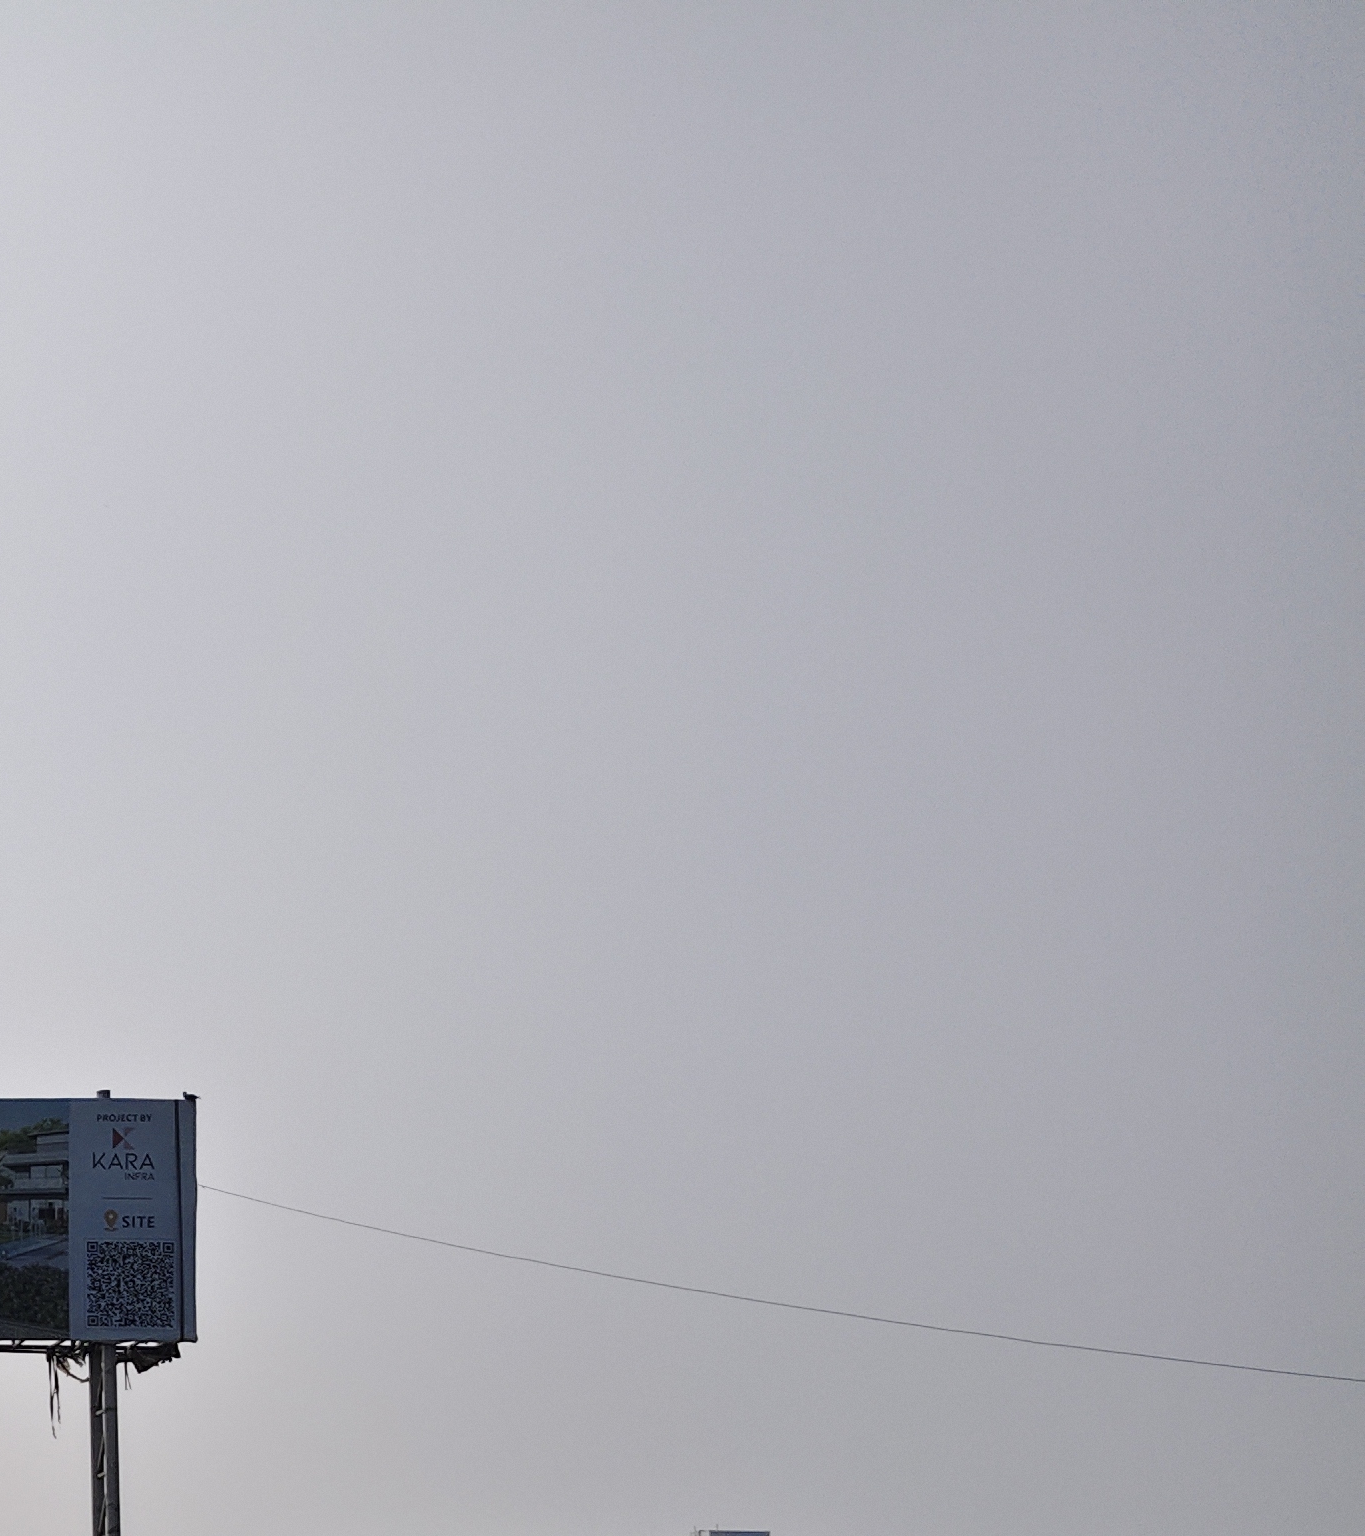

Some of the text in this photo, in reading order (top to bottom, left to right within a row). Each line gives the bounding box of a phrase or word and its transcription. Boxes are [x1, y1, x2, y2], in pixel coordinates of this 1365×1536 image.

[96, 1114, 152, 1122] PROJECT BY
[92, 1152, 155, 1171] KARA
[124, 1172, 155, 1181] INFRA
[122, 1215, 155, 1228] SITE
